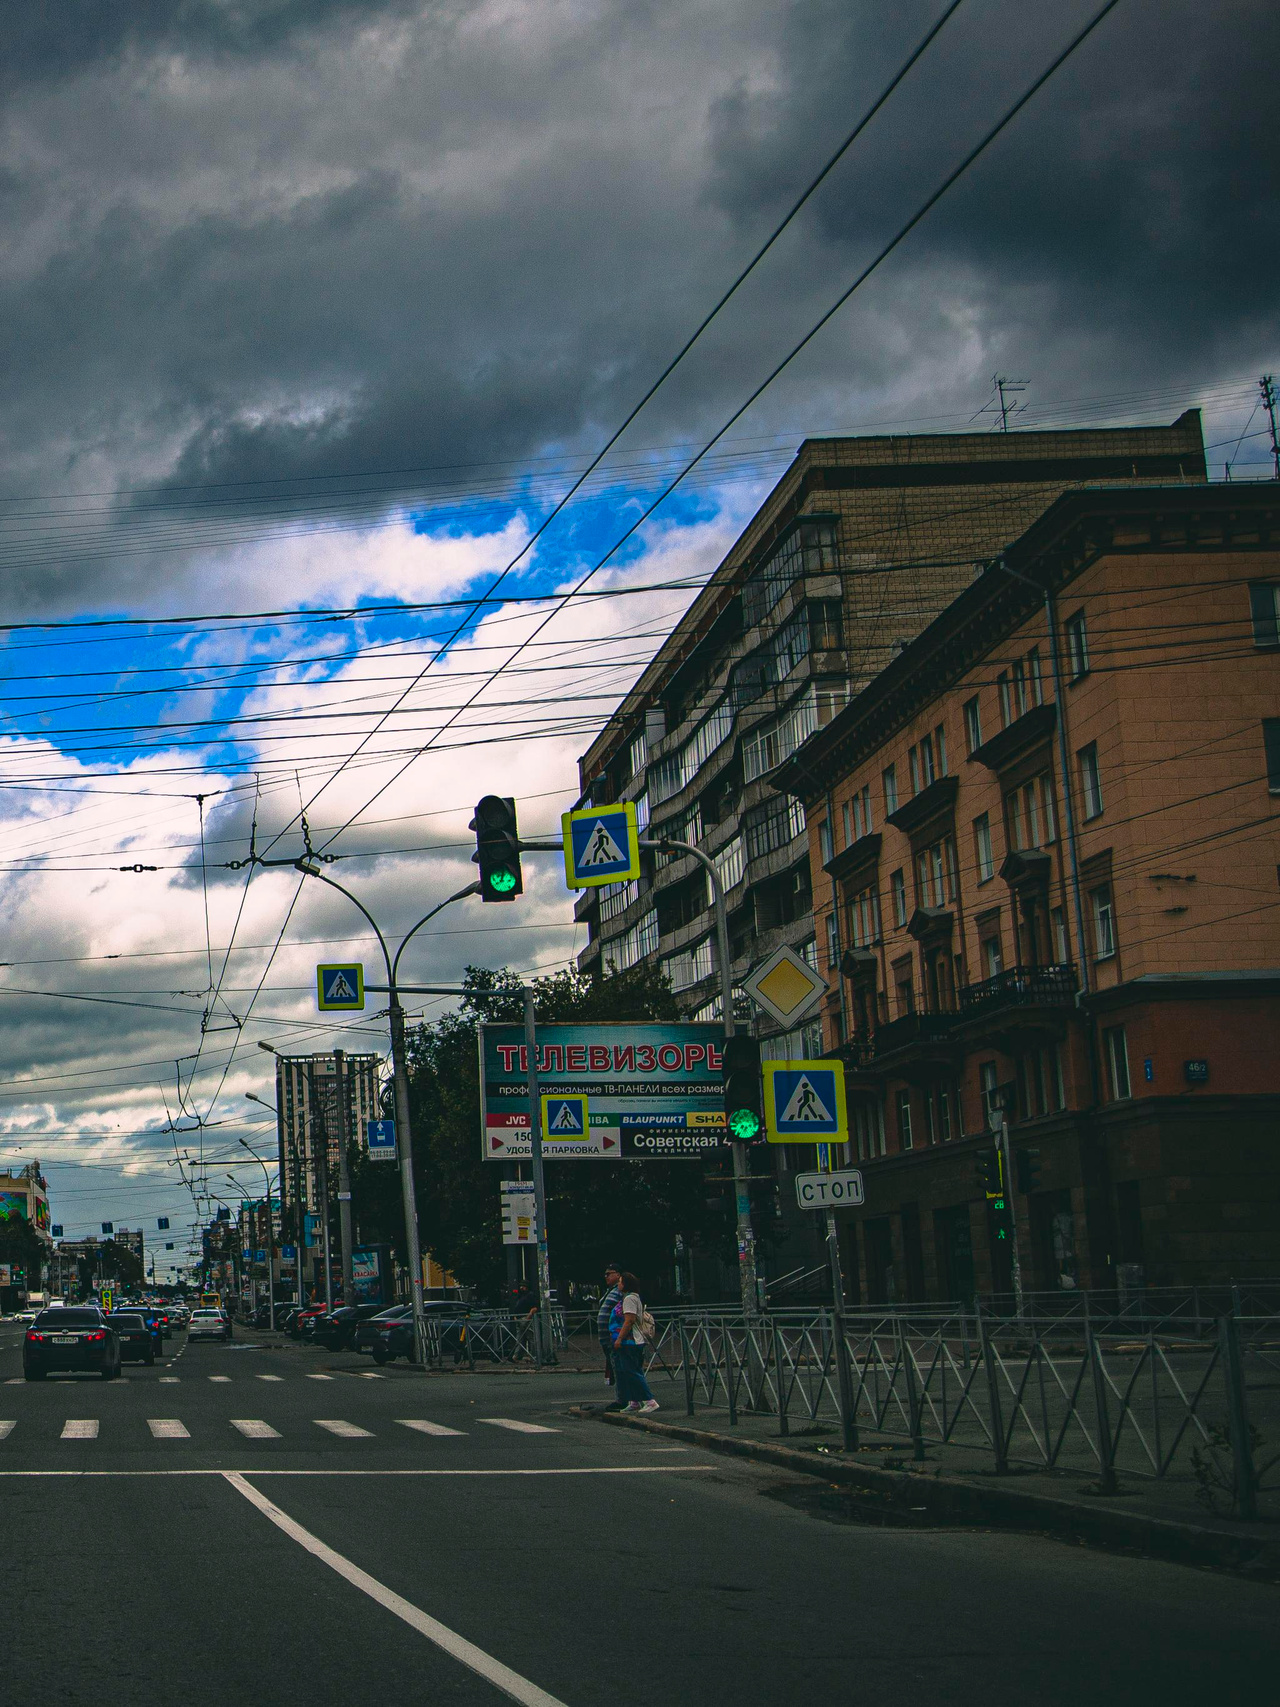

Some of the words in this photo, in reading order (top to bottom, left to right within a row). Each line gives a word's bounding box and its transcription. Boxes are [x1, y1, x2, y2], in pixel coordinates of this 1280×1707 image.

[499, 1086, 602, 1095] профсиональные
[604, 1084, 658, 1094] ТВ-ПАНЕЛИ
[662, 1085, 685, 1093] всех
[506, 1116, 526, 1125] JVC
[622, 1115, 684, 1124] BLAUPUNKT
[633, 1134, 717, 1147] Советская
[506, 1146, 549, 1155] УДОБЯ
[551, 1145, 600, 1154] ПАРКОВКА
[802, 1180, 859, 1201] СТОП
[994, 1199, 1005, 1209] 28
